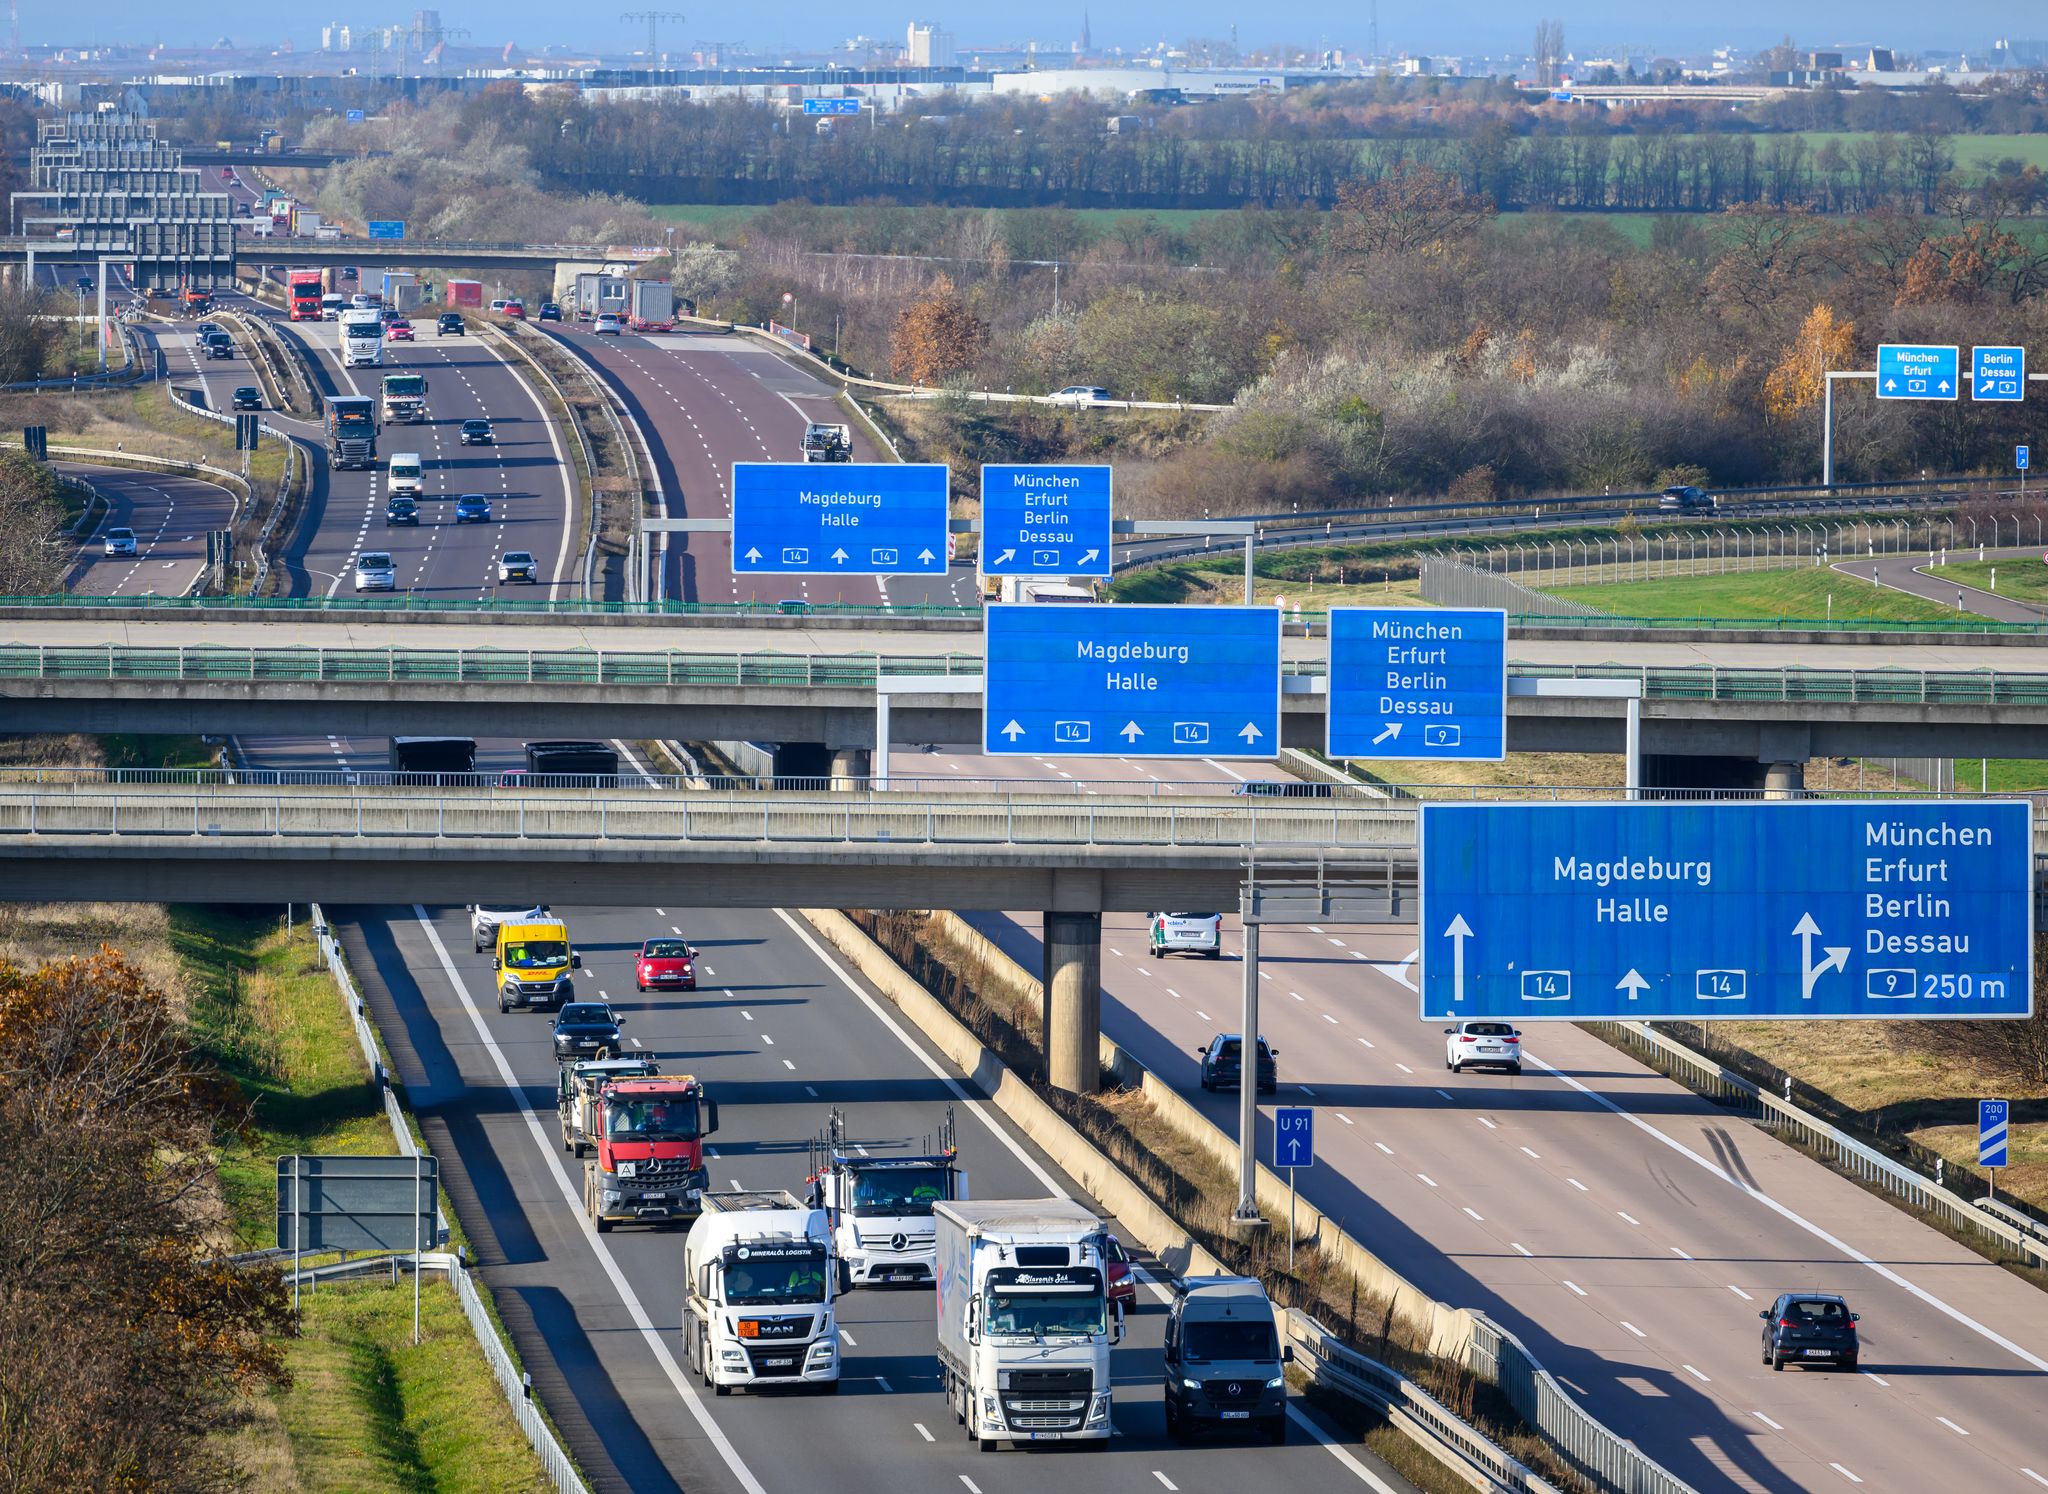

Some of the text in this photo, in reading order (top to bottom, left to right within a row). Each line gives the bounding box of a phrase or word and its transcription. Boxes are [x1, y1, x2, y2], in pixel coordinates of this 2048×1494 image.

[1896, 351, 1939, 363] München
[1983, 353, 2013, 364] Berlin
[1903, 365, 1932, 376] Erfurt
[1980, 366, 2016, 378] Dessau
[1914, 381, 1920, 390] 9
[2005, 381, 2011, 391] 9
[1014, 474, 1079, 488] München
[800, 491, 881, 508] Magdeburg
[1025, 492, 1068, 506] Erfurt
[821, 513, 859, 526] Halle
[1024, 511, 1068, 524] Berlin
[1019, 529, 1073, 543] Dessau
[790, 550, 801, 561] 14
[879, 551, 890, 562] 14
[1042, 552, 1049, 563] 9
[1373, 621, 1462, 639] München
[1077, 640, 1189, 664] Magdeburg
[1388, 646, 1446, 664] Erfurt
[1107, 672, 1158, 690] Halle
[1387, 671, 1446, 689] Berlin
[1380, 696, 1453, 715] Dessau
[1065, 724, 1080, 739] 14
[1183, 725, 1199, 740] 14
[1438, 728, 1447, 744] 9
[1866, 822, 1992, 846] München
[1554, 856, 1711, 887] Magdeburg
[1866, 858, 1948, 882] Erfurt
[1597, 898, 1668, 923] Halle
[1866, 893, 1950, 918] Berlin
[1866, 929, 1969, 954] Dessau
[1536, 976, 1556, 994] 14
[1711, 975, 1731, 993] 14
[1886, 974, 2005, 999] 9 250 m
[1985, 1104, 2003, 1114] 200
[1281, 1117, 1308, 1131] U 91
[621, 1164, 632, 1175] A
[751, 1249, 785, 1257] MINERALÖL
[761, 1325, 794, 1334] MAN
